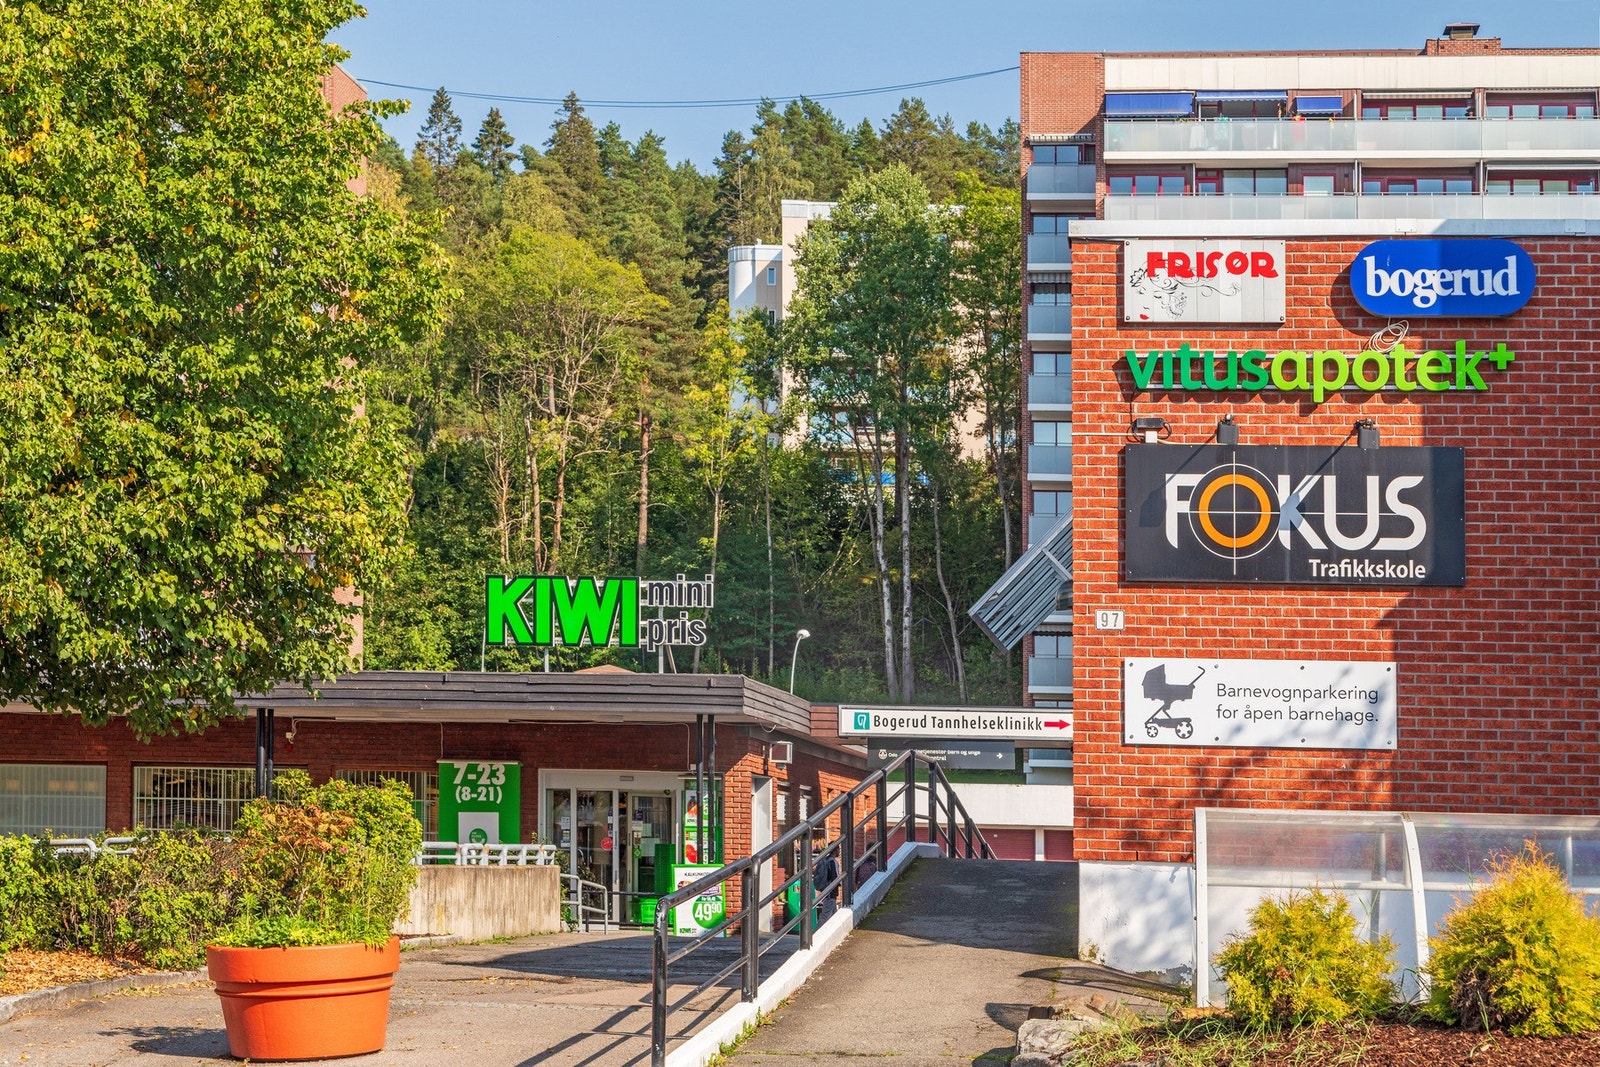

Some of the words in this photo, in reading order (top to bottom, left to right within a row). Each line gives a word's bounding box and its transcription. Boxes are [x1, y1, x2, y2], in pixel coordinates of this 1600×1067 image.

[1146, 250, 1279, 279] FRISØR
[1363, 254, 1520, 308] bogerud
[1164, 473, 1428, 552] FOKUS
[1309, 558, 1426, 579] Trafikkskole
[647, 573, 714, 608] mini
[485, 574, 642, 648] KIWI
[647, 611, 707, 652] pris
[1216, 683, 1379, 704] Barnevognparkering
[873, 715, 927, 731] Bogerud
[931, 716, 1043, 731] Tannhelseklinikk
[1216, 704, 1239, 719] for
[1244, 705, 1283, 723] åpen
[1288, 706, 1379, 726] barnehage.
[453, 763, 506, 785] 7-23
[455, 786, 503, 804] (8-21)
